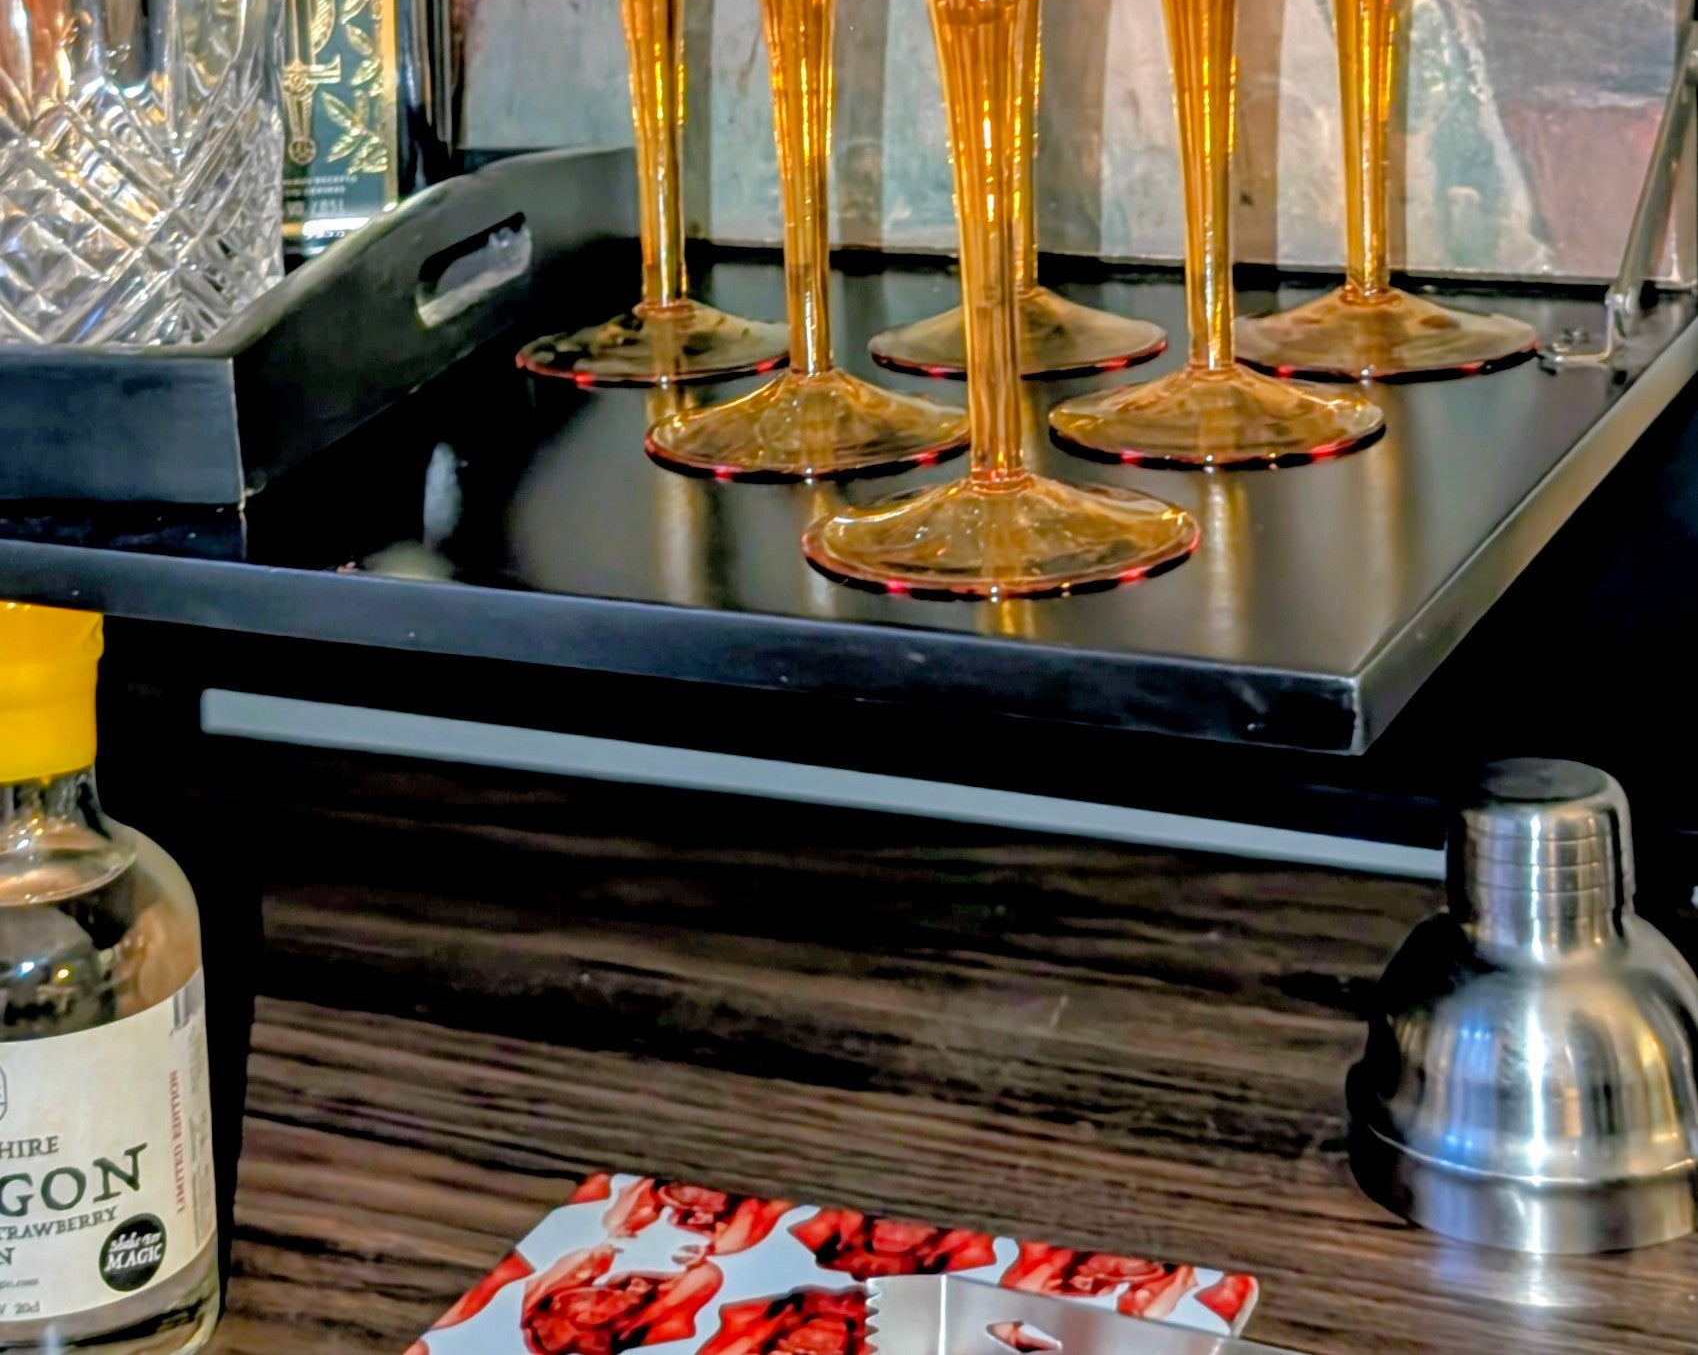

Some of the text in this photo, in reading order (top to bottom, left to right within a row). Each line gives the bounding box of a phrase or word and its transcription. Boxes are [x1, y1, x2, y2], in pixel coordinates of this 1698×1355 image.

[169, 1069, 187, 1214] LIMITED EDITION
[104, 1243, 163, 1272] MAGIC
